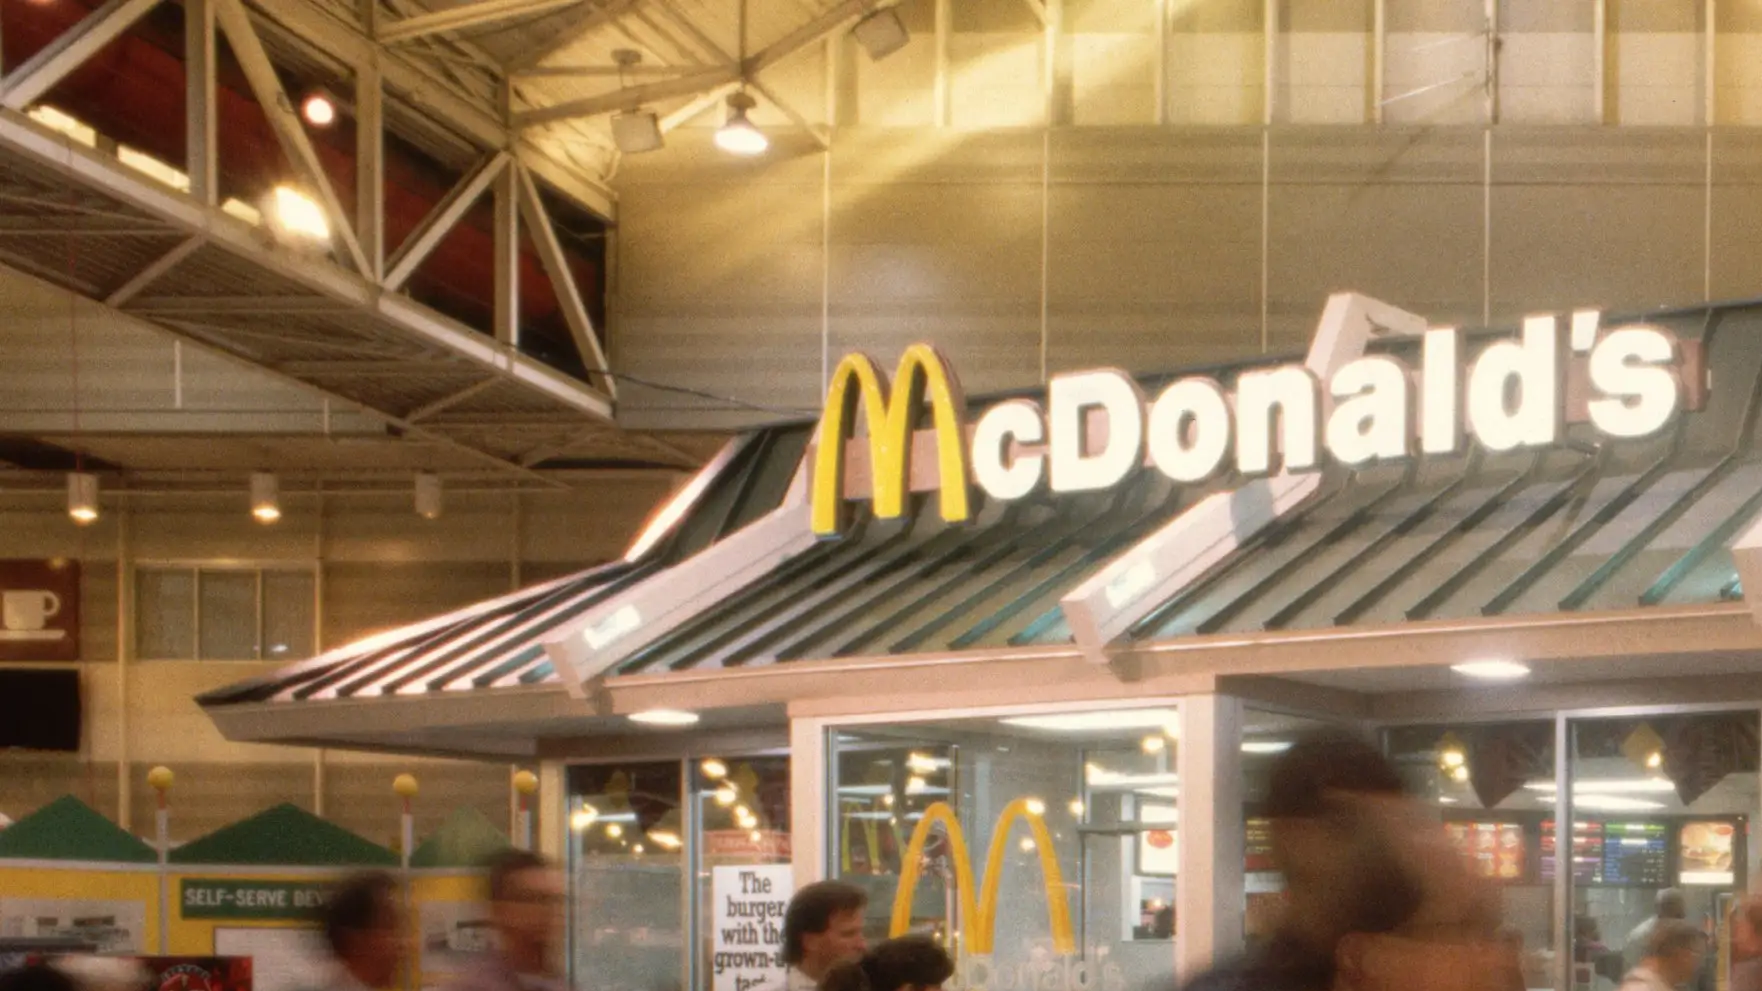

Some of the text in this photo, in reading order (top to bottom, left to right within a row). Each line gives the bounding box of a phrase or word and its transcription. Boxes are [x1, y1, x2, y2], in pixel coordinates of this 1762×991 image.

[811, 308, 1681, 540] McDonald's
[739, 871, 772, 894] The
[184, 888, 288, 908] SELF-SERVE
[726, 895, 786, 924] burger
[722, 922, 788, 945] with the
